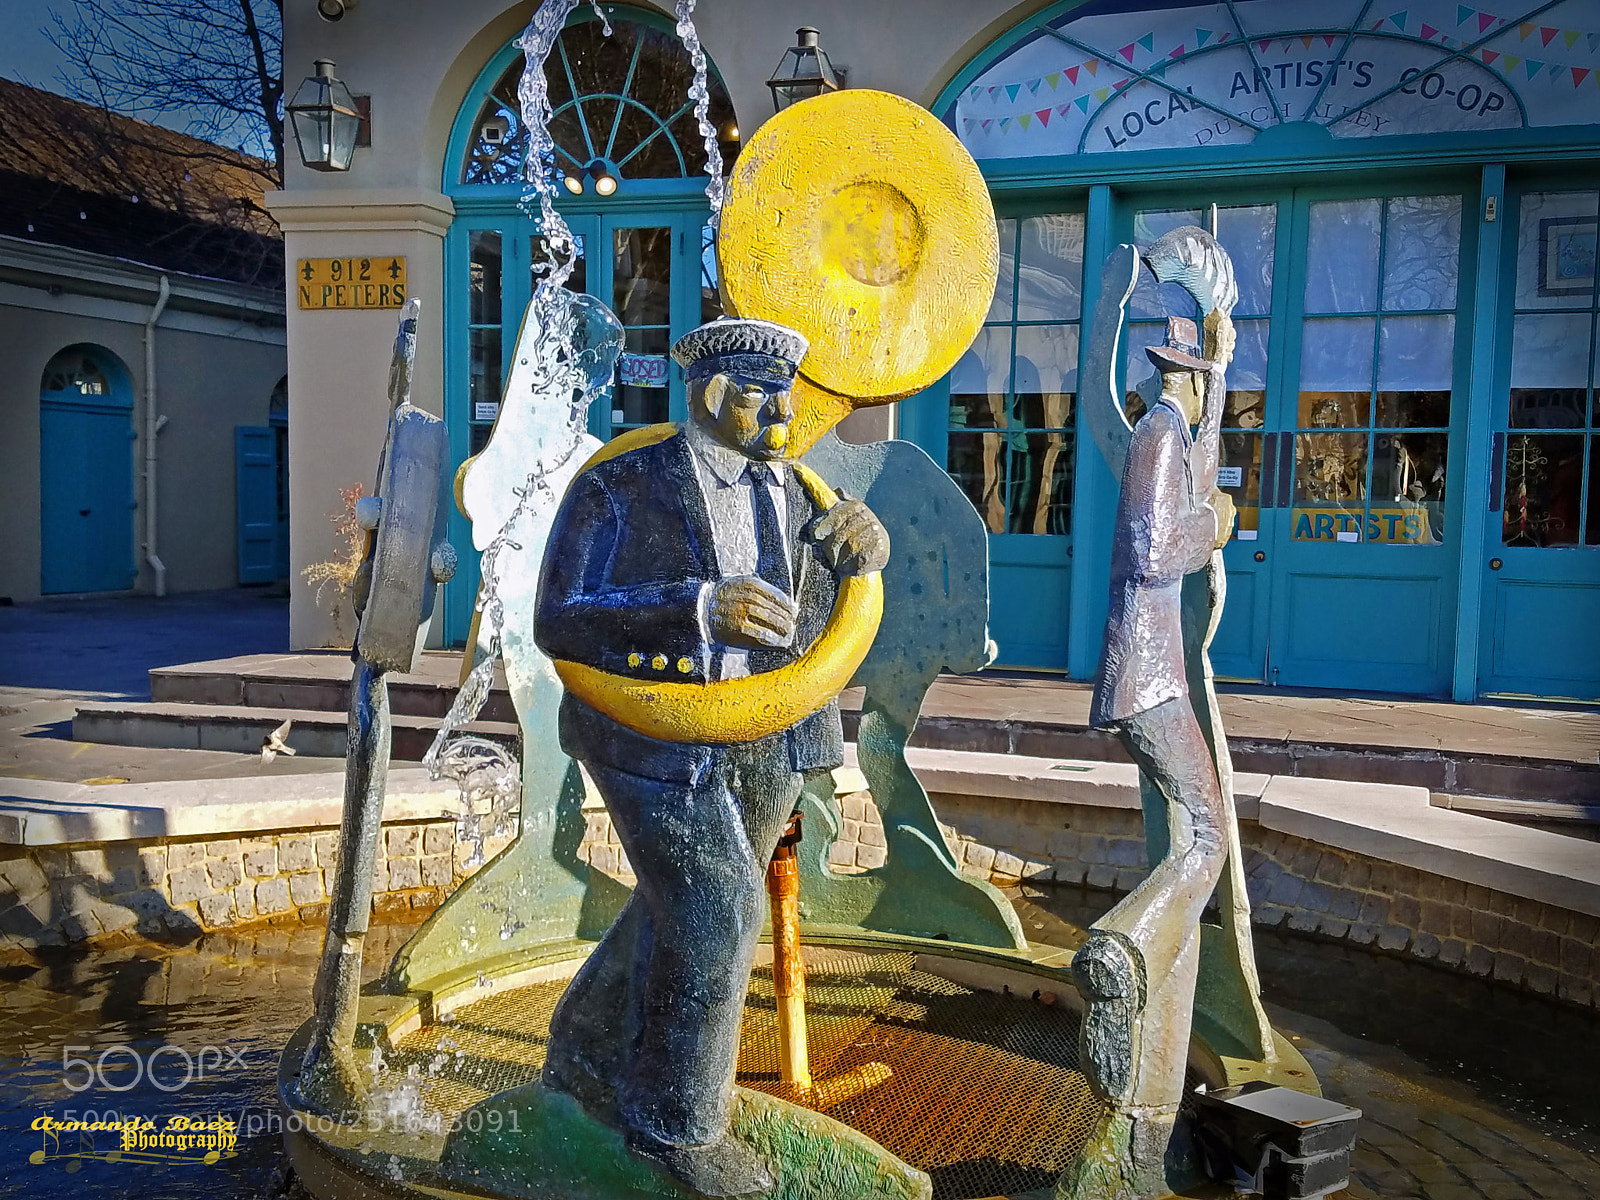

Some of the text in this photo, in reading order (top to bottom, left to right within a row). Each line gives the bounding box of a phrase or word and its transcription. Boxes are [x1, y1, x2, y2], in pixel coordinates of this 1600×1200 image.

[1105, 61, 1505, 148] LOCAL ARTIST'S CO-OP
[1194, 103, 1391, 145] DUTCH ALLEY
[331, 259, 371, 281] 912
[321, 284, 405, 307] PETERS
[620, 359, 668, 379] CLOSED
[1294, 513, 1421, 540] ARTISTS
